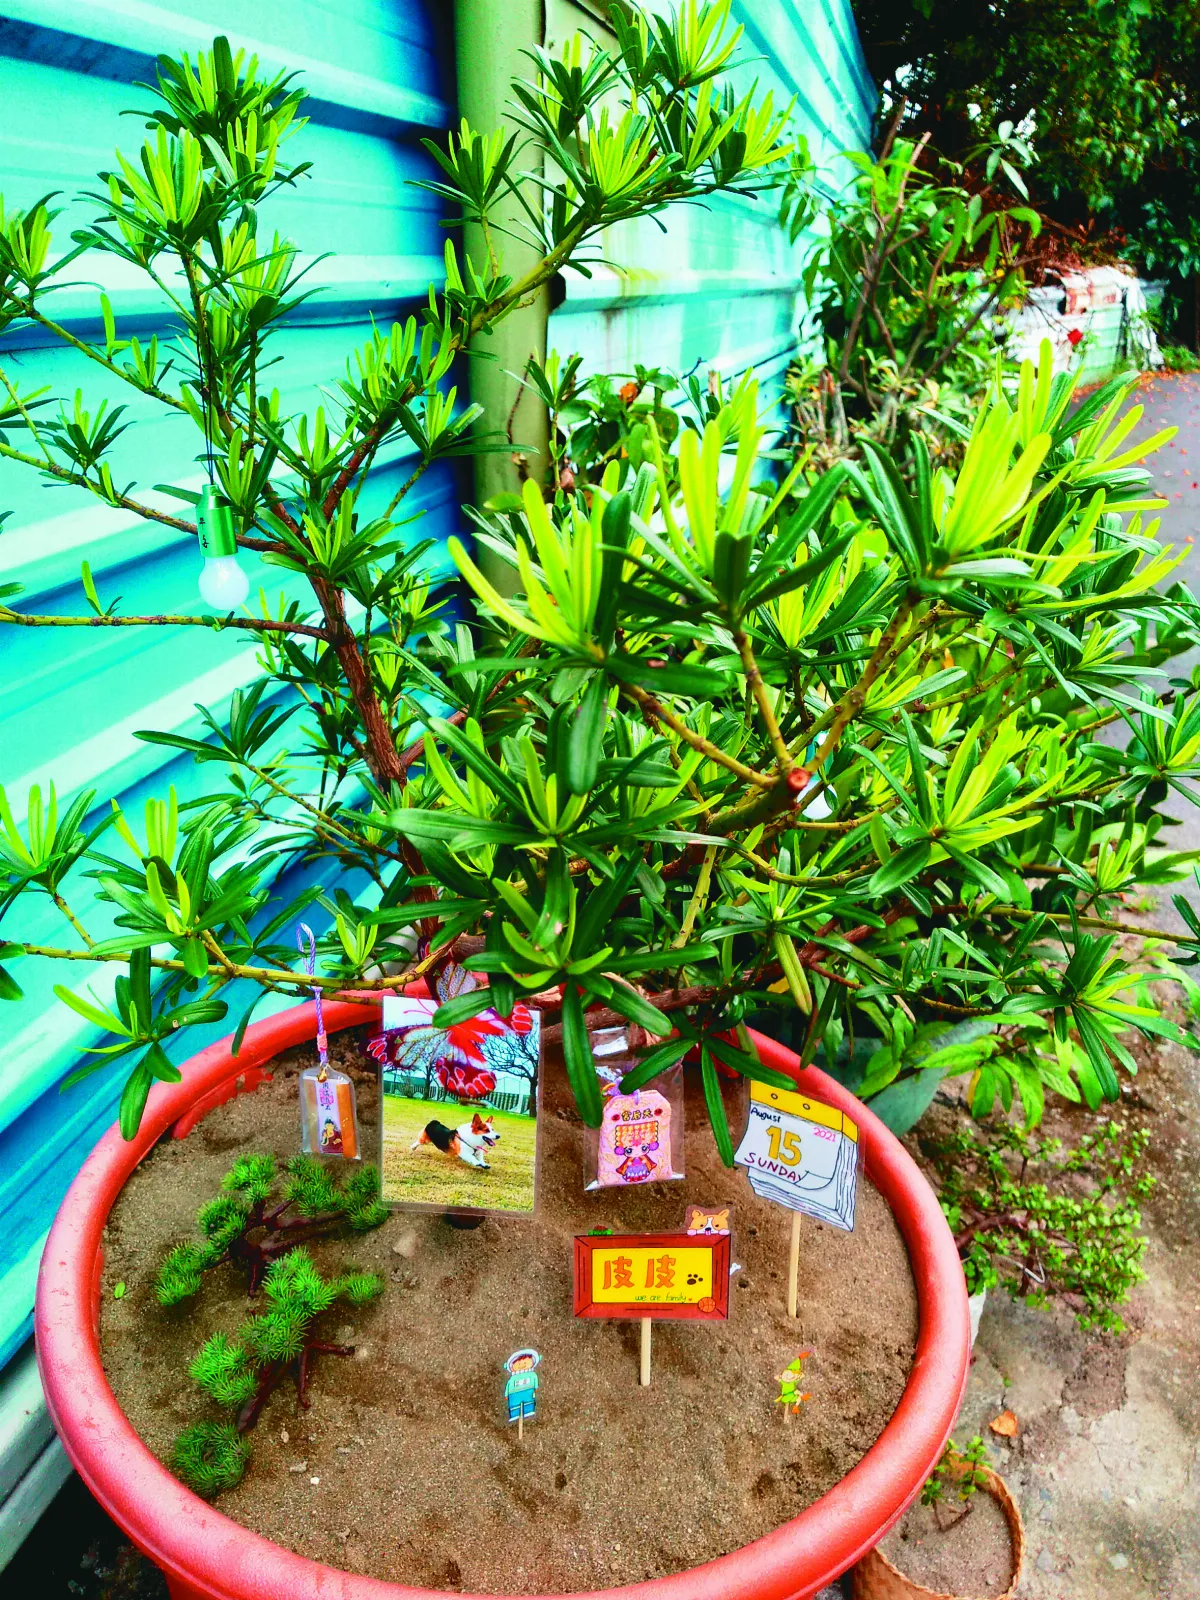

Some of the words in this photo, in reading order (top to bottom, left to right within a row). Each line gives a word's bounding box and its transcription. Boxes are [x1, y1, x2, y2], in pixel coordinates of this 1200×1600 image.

[750, 1106, 781, 1122] August
[766, 1125, 802, 1166] 15
[813, 1127, 837, 1142] 2021
[744, 1152, 801, 1182] SUNDAY
[602, 1254, 676, 1289] 皮皮
[665, 1292, 687, 1304] family
